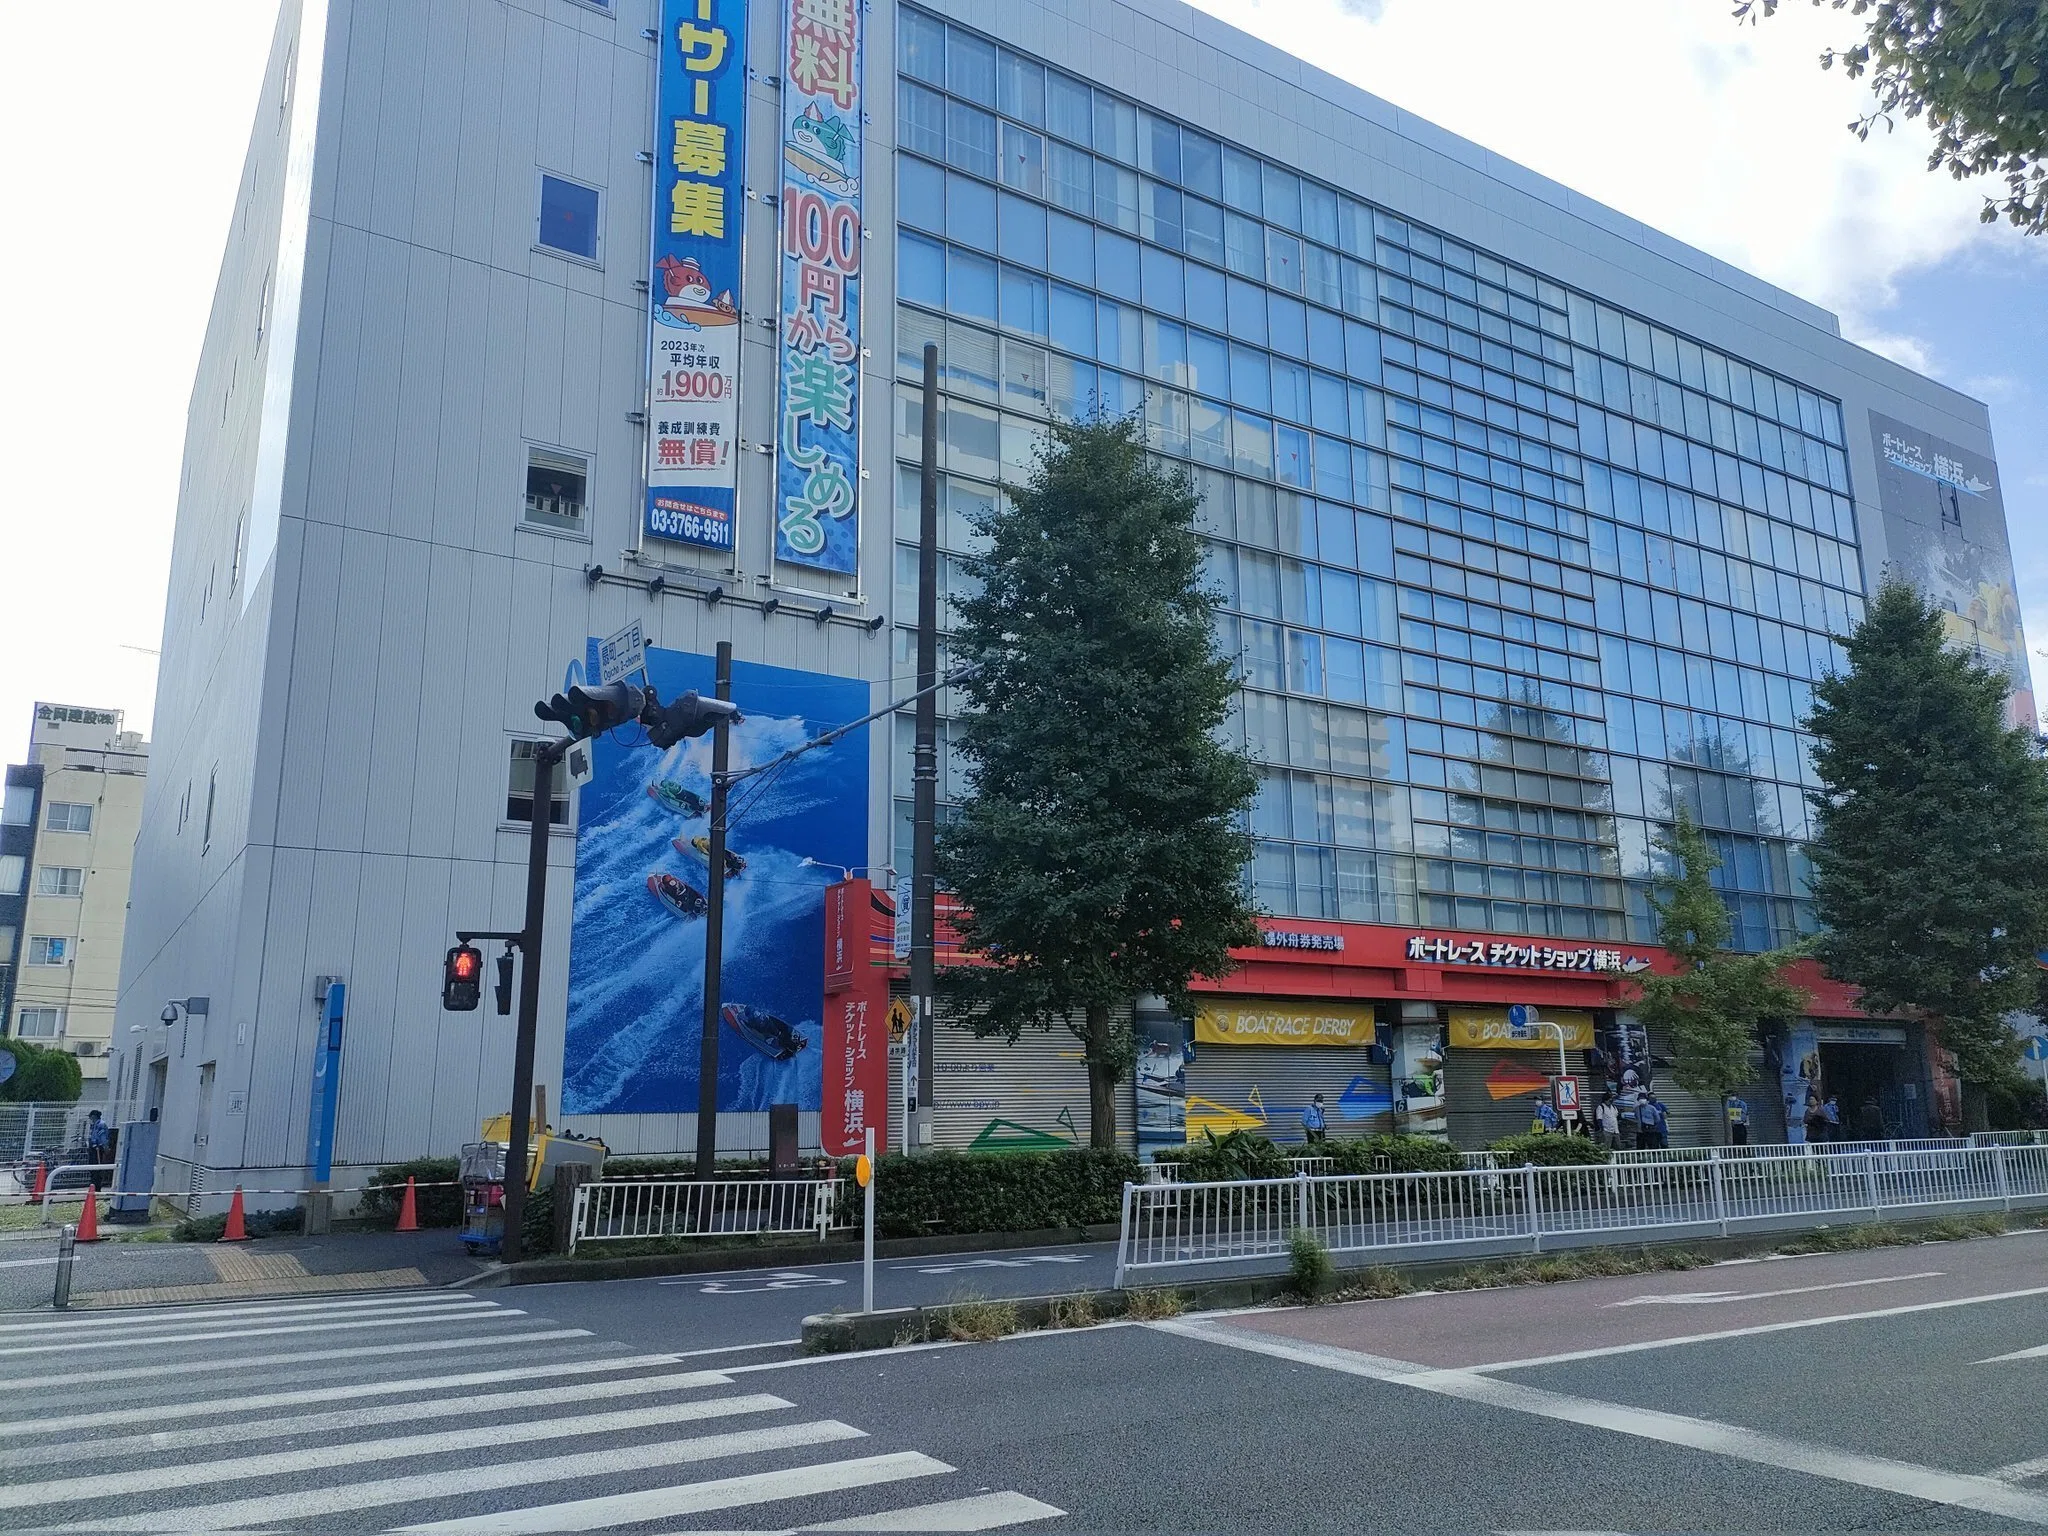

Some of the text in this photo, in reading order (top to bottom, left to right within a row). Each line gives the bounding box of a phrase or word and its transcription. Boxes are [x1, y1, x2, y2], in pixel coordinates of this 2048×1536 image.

[791, 0, 857, 109] 無料
[661, 340, 705, 353] 2023年次
[670, 353, 720, 369] 平均年収
[782, 187, 861, 552] 100円から楽しめる
[658, 421, 720, 436] 養成訓練費
[1883, 432, 1923, 460] ボートレース
[1934, 453, 1965, 487] 横浜
[651, 508, 729, 545] 03-3766-9511
[1409, 936, 1485, 963] ボートレース
[1593, 949, 1622, 972] 横浜
[857, 1001, 868, 1059] ボートレース
[1312, 1017, 1355, 1036] DERBY
[843, 1089, 864, 1134] 横浜
